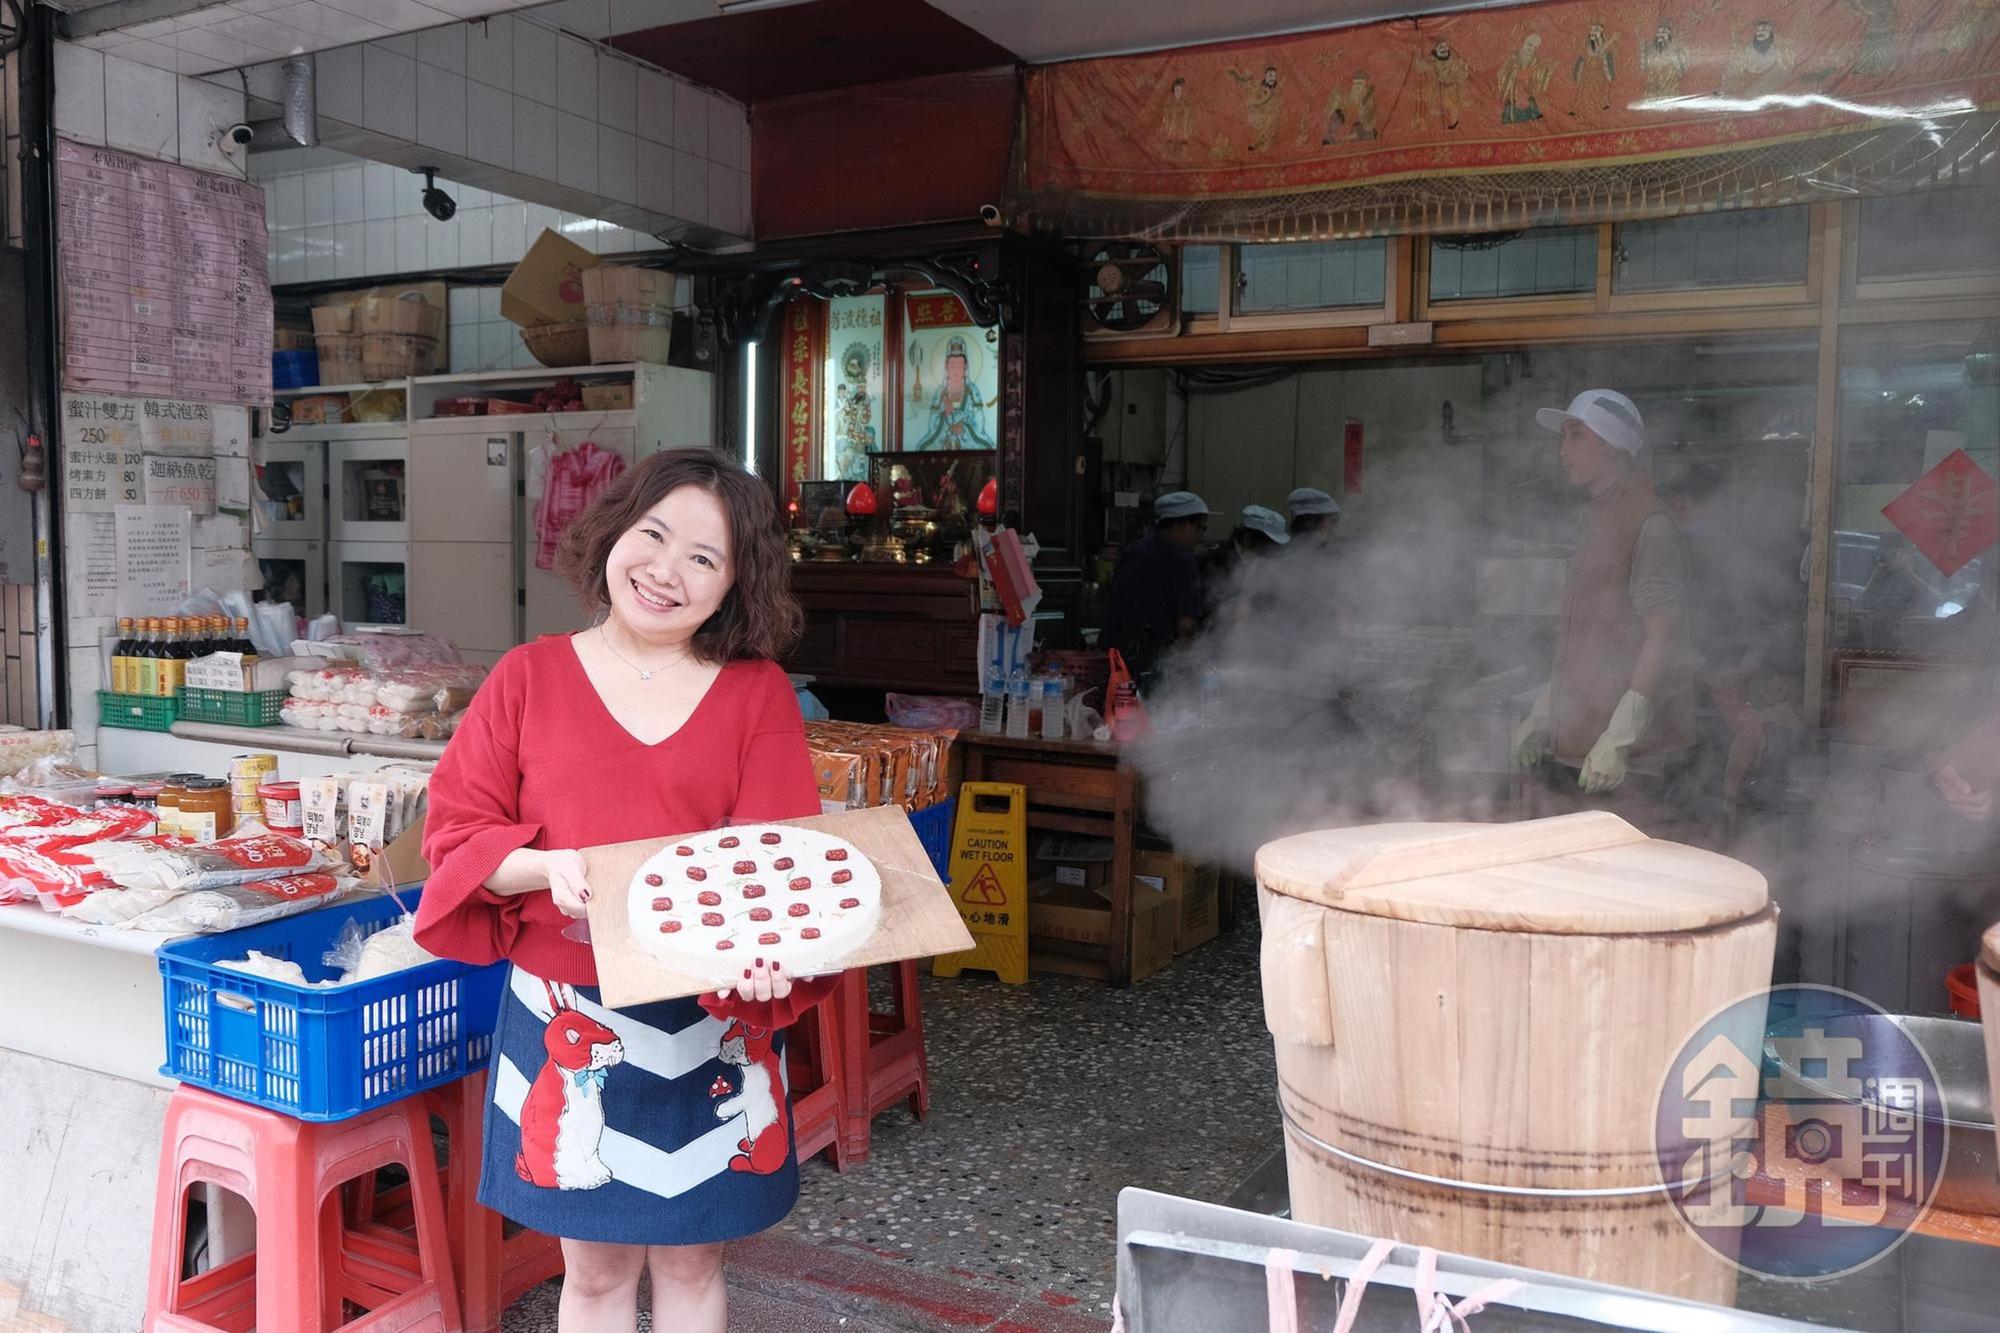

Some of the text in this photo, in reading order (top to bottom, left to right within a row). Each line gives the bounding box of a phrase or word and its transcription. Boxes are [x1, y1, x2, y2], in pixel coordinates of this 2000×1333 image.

[914, 300, 966, 324] 普照
[68, 401, 135, 421] 蜜汁雙方
[143, 400, 209, 420] 韓式泡菜
[69, 451, 141, 465] 蜜汁火腿 120
[69, 468, 107, 482] 烤素方
[69, 487, 107, 501] 四方餅
[967, 838, 1009, 850] CAUTION
[960, 850, 1014, 863] WET FLOOR
